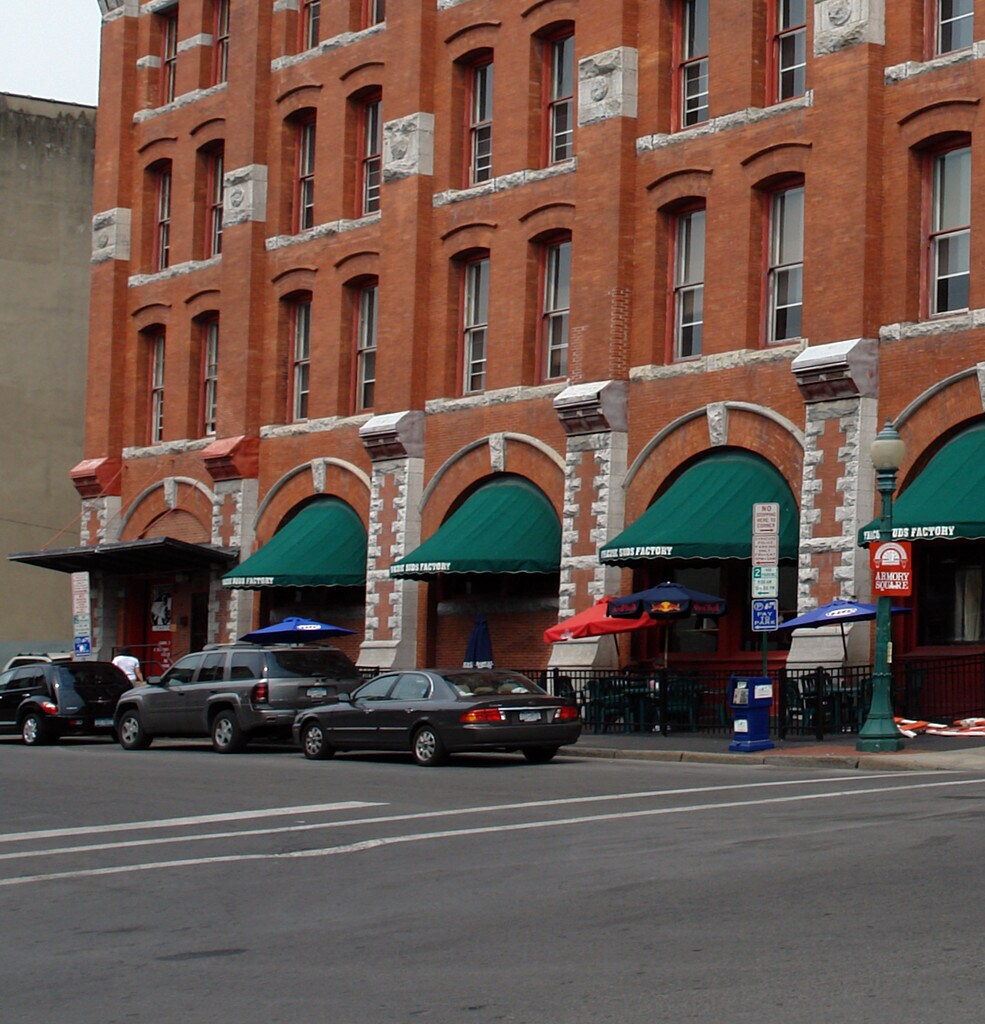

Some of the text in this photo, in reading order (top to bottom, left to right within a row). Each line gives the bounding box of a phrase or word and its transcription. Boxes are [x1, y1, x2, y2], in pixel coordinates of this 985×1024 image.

[892, 528, 909, 538] UDS
[911, 526, 955, 537] FACTORY
[636, 546, 673, 555] FACTORY
[420, 562, 451, 570] FACTORY
[875, 572, 910, 580] ARMORY
[875, 581, 908, 591] SQUARE
